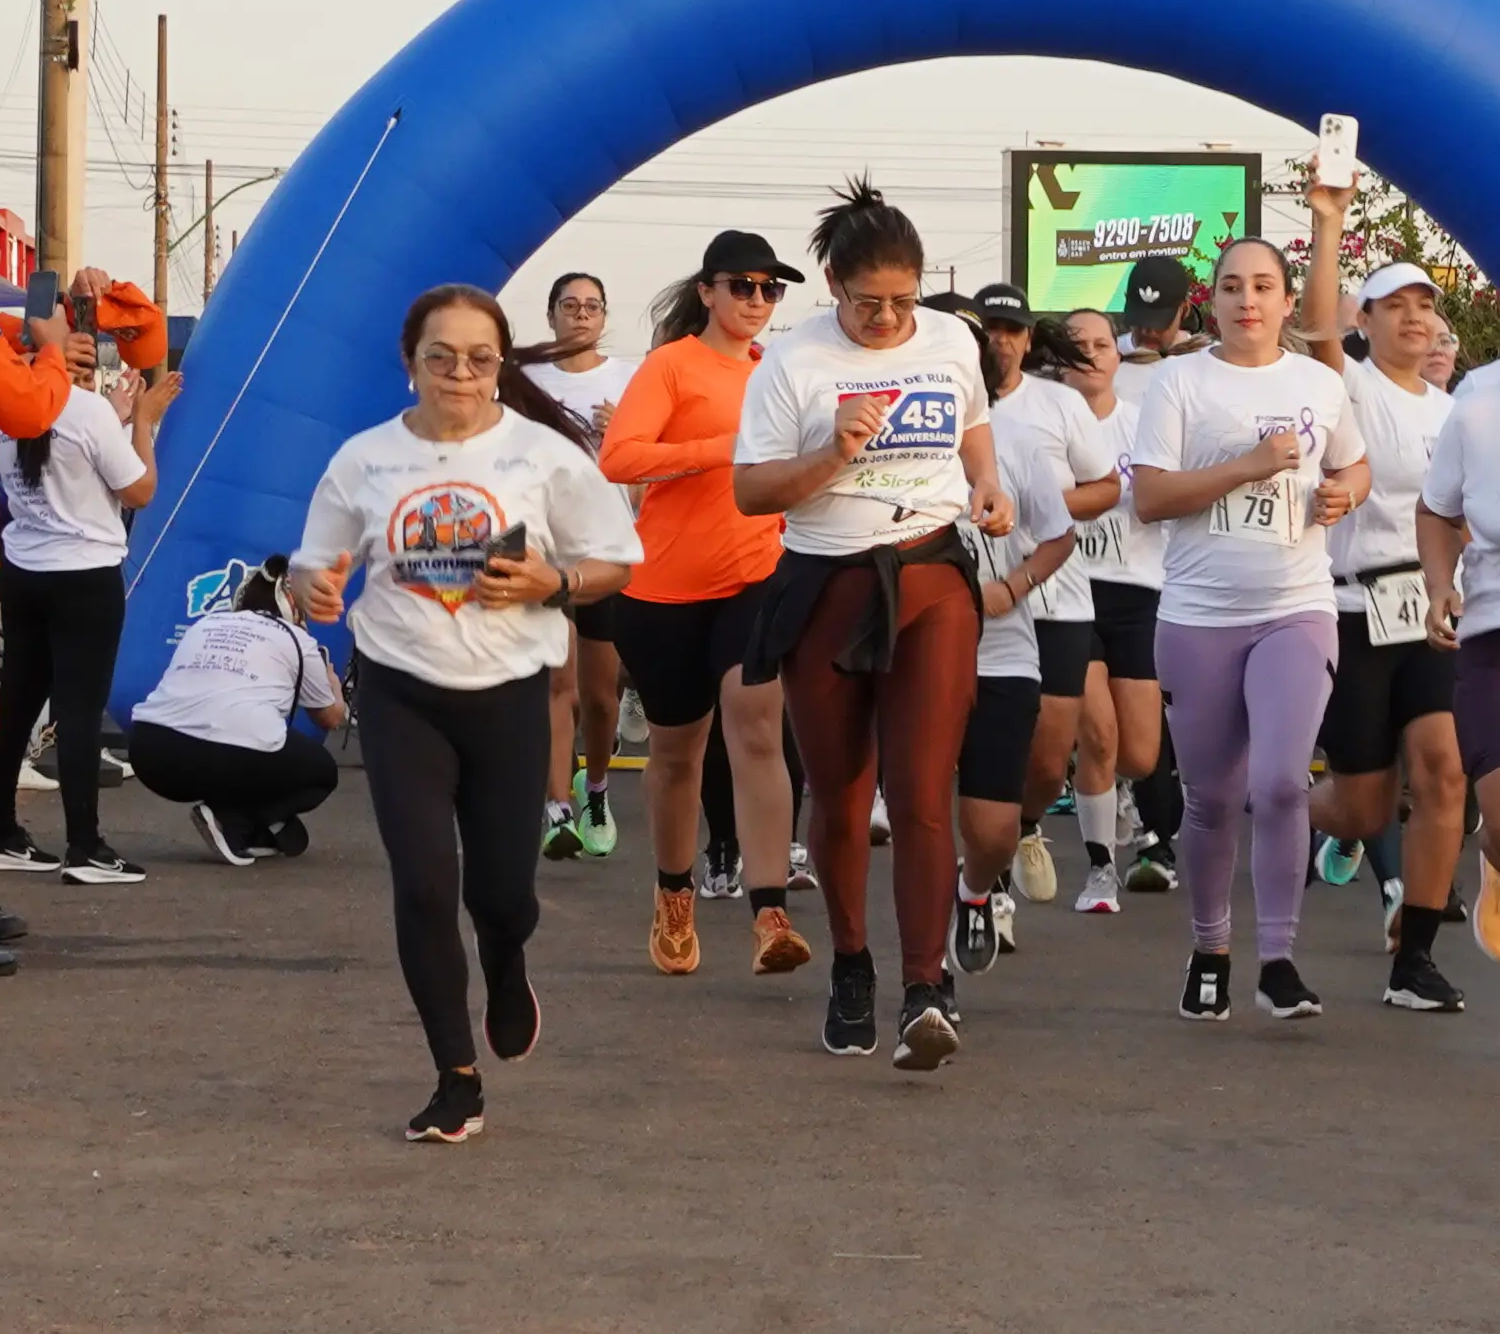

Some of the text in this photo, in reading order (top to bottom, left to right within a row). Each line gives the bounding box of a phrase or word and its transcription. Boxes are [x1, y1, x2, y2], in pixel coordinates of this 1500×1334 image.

[1094, 212, 1194, 248] 9290-7508
[1099, 250, 1127, 261] entre
[1129, 249, 1146, 258] em
[835, 373, 953, 391] CORRIDA DE RUA
[890, 431, 955, 444] ANIVERSÁRIO
[1244, 495, 1275, 527] 79
[1398, 598, 1419, 627] 41
